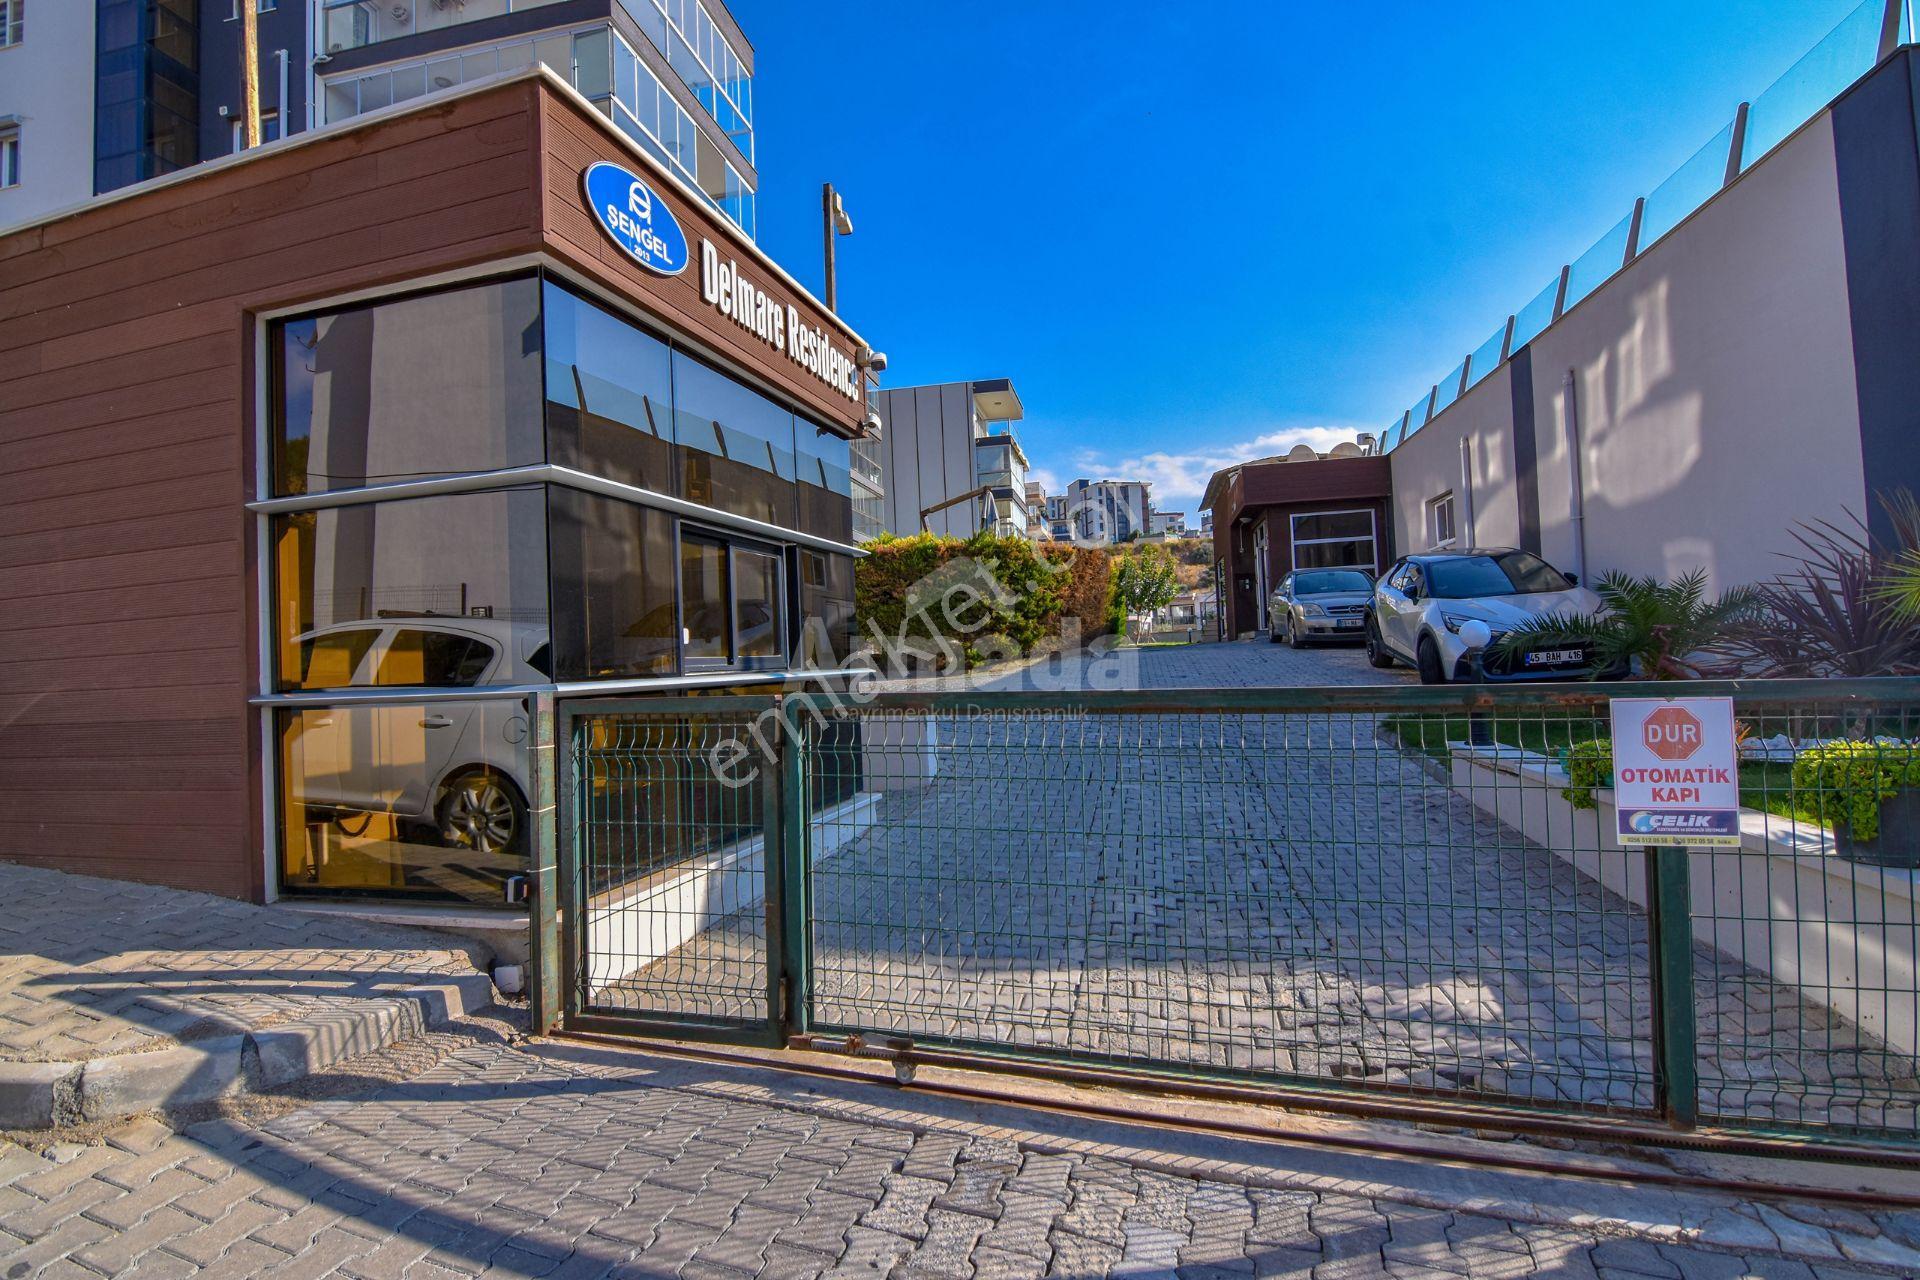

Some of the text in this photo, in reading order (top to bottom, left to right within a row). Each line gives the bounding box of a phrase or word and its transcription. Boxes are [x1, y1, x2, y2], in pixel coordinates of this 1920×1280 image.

[634, 244, 651, 262] 2013
[703, 238, 859, 401] Delmare Residence
[1647, 724, 1697, 743] DUR
[1621, 764, 1730, 784] OTOMATİK
[1652, 787, 1700, 803] KAPI
